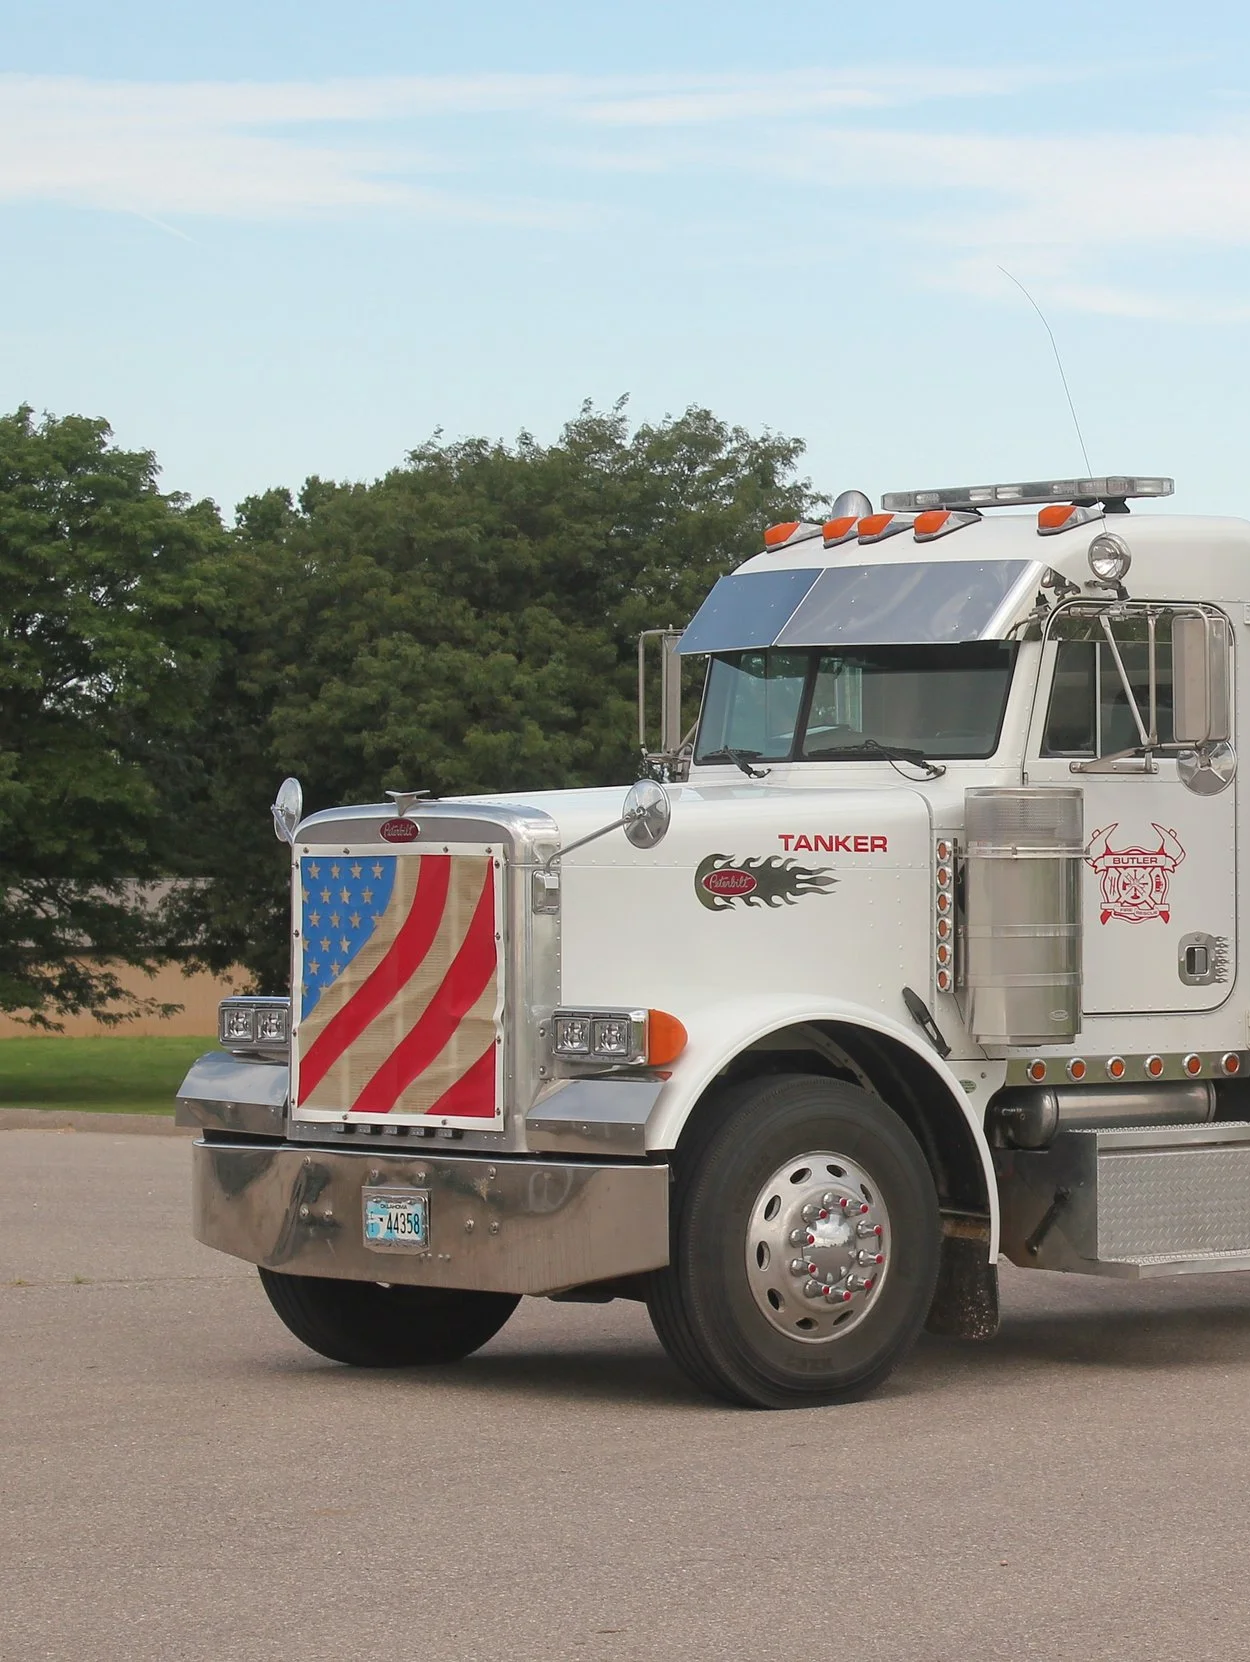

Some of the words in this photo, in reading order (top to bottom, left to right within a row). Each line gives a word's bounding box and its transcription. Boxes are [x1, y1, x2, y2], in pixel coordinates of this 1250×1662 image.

[778, 834, 888, 853] TANKER
[1112, 856, 1158, 865] BUTLER
[709, 873, 751, 889] Peterbilt
[386, 1212, 420, 1235] 44358
